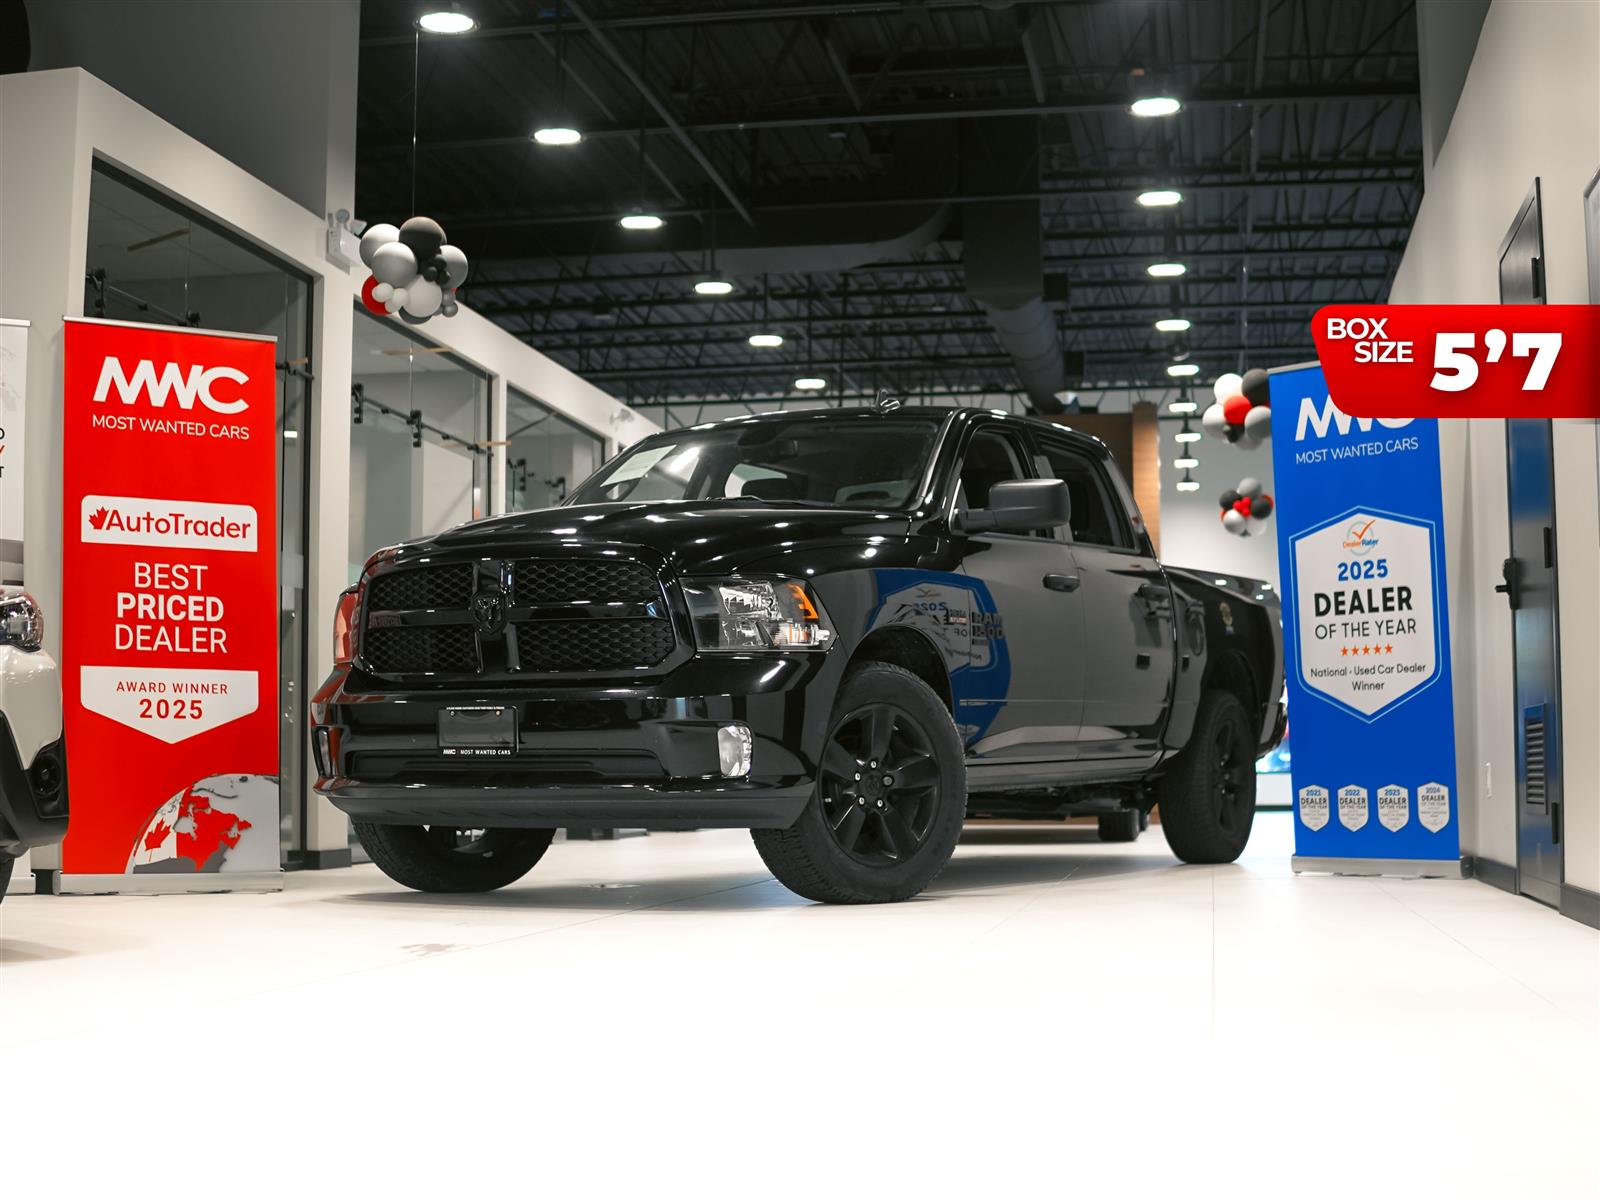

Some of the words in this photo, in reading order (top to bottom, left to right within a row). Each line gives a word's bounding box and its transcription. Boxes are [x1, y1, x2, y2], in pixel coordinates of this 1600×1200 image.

[93, 356, 249, 414] MWC
[92, 414, 136, 431] MOST
[140, 418, 206, 437] WANTED
[209, 424, 249, 440] CARS
[1296, 449, 1328, 464] MOST
[1331, 442, 1383, 460] WANTED
[1386, 437, 1419, 453] CARS
[106, 509, 251, 539] AutoTrader
[134, 562, 208, 591] BEST
[1338, 559, 1388, 581] 2025
[117, 592, 224, 622] PRICED
[1314, 586, 1413, 617] DEALER
[115, 624, 227, 653] DEALER
[1315, 623, 1337, 640] OF
[1341, 621, 1370, 638] THE
[1374, 618, 1417, 636] YEAR
[1310, 667, 1347, 678] National
[1354, 665, 1376, 676] Used
[1378, 665, 1394, 675] Car
[1397, 663, 1426, 674] Dealer
[116, 680, 167, 694] AWARD
[172, 682, 228, 695] WINNER
[1352, 681, 1384, 691] Winner
[139, 699, 203, 719] 2025
